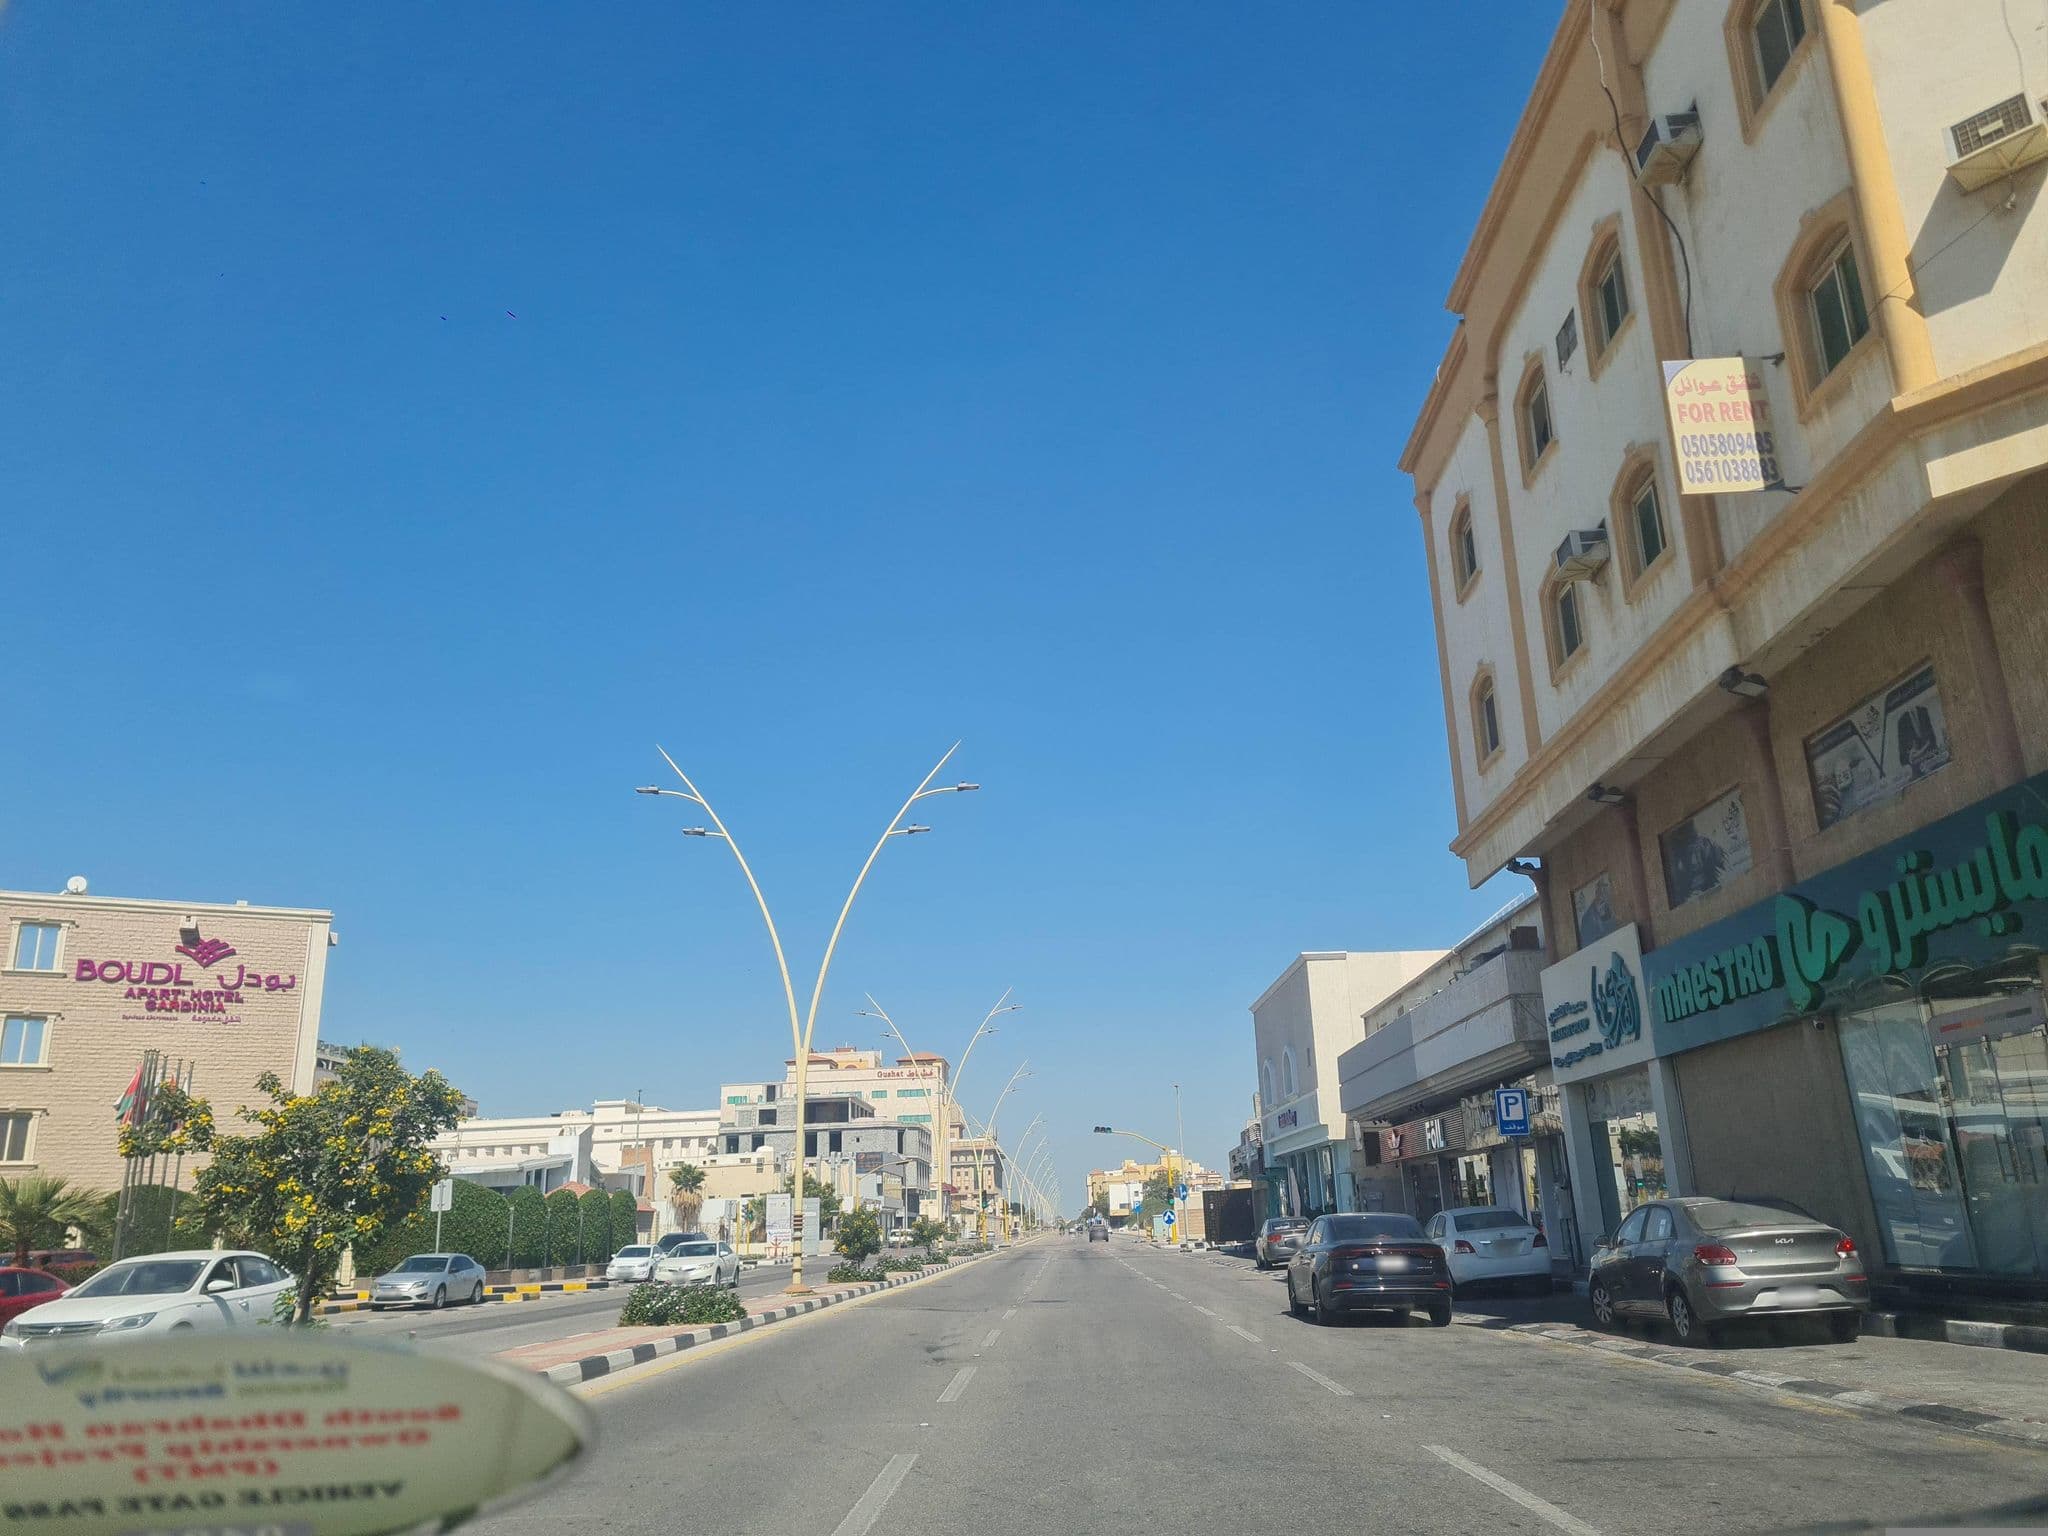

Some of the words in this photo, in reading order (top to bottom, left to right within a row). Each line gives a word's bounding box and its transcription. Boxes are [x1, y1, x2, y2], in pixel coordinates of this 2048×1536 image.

[1677, 402, 1716, 423] FOR
[1719, 400, 1769, 421] RENT
[75, 958, 193, 986] BOUDL
[217, 964, 296, 992] بودل
[190, 990, 244, 1004] HOTEL
[1504, 1096, 1519, 1117] P
